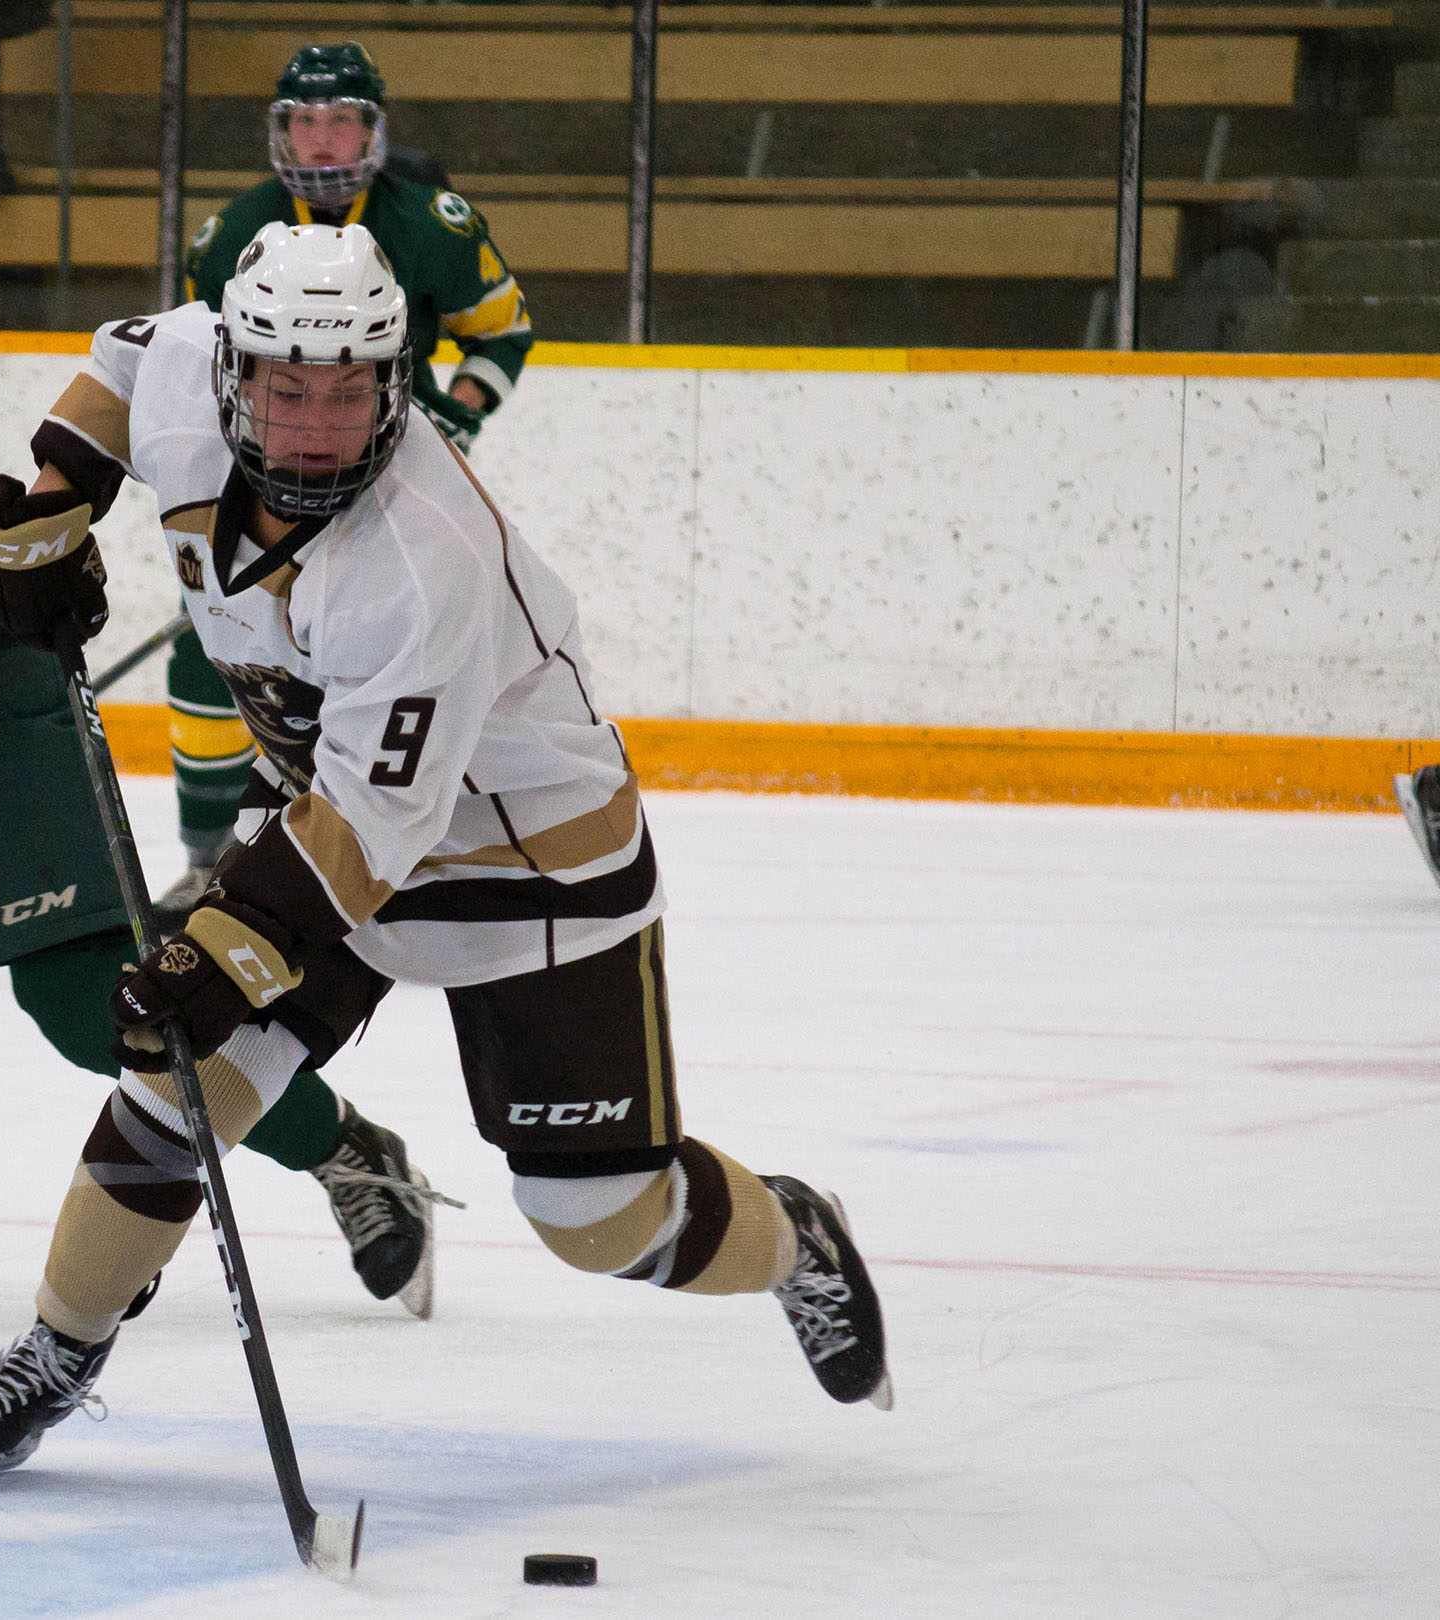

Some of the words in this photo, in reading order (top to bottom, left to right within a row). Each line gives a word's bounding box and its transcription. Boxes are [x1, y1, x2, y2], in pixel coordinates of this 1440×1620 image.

[292, 317, 354, 329] CCM
[368, 696, 437, 788] 9
[122, 985, 149, 1016] CCM
[507, 1097, 634, 1126] CCM
